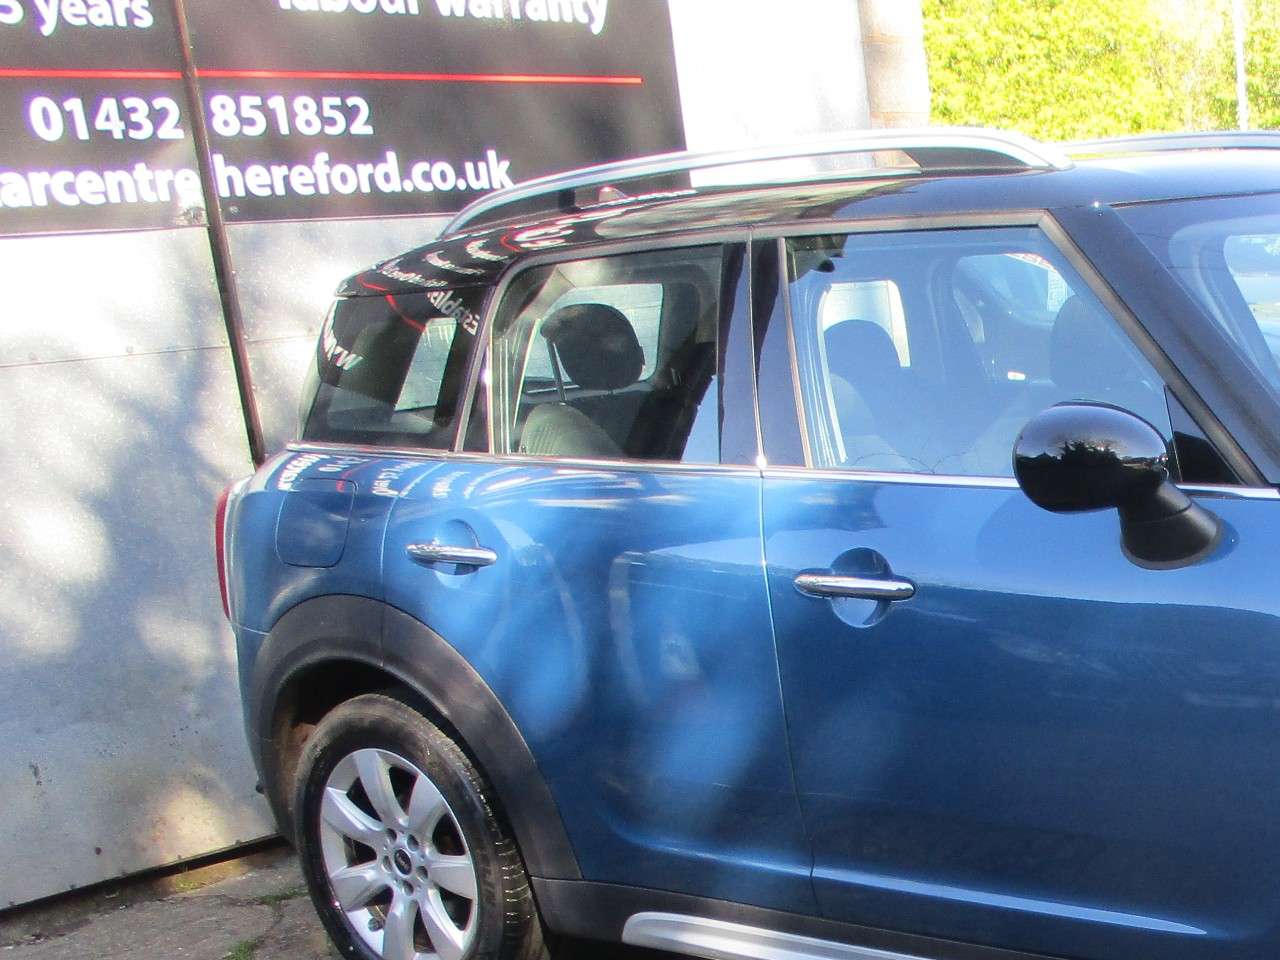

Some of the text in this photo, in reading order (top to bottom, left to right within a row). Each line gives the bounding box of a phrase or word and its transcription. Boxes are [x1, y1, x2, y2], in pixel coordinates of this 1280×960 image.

[35, 0, 154, 37] years
[29, 95, 374, 142] 01432 851852
